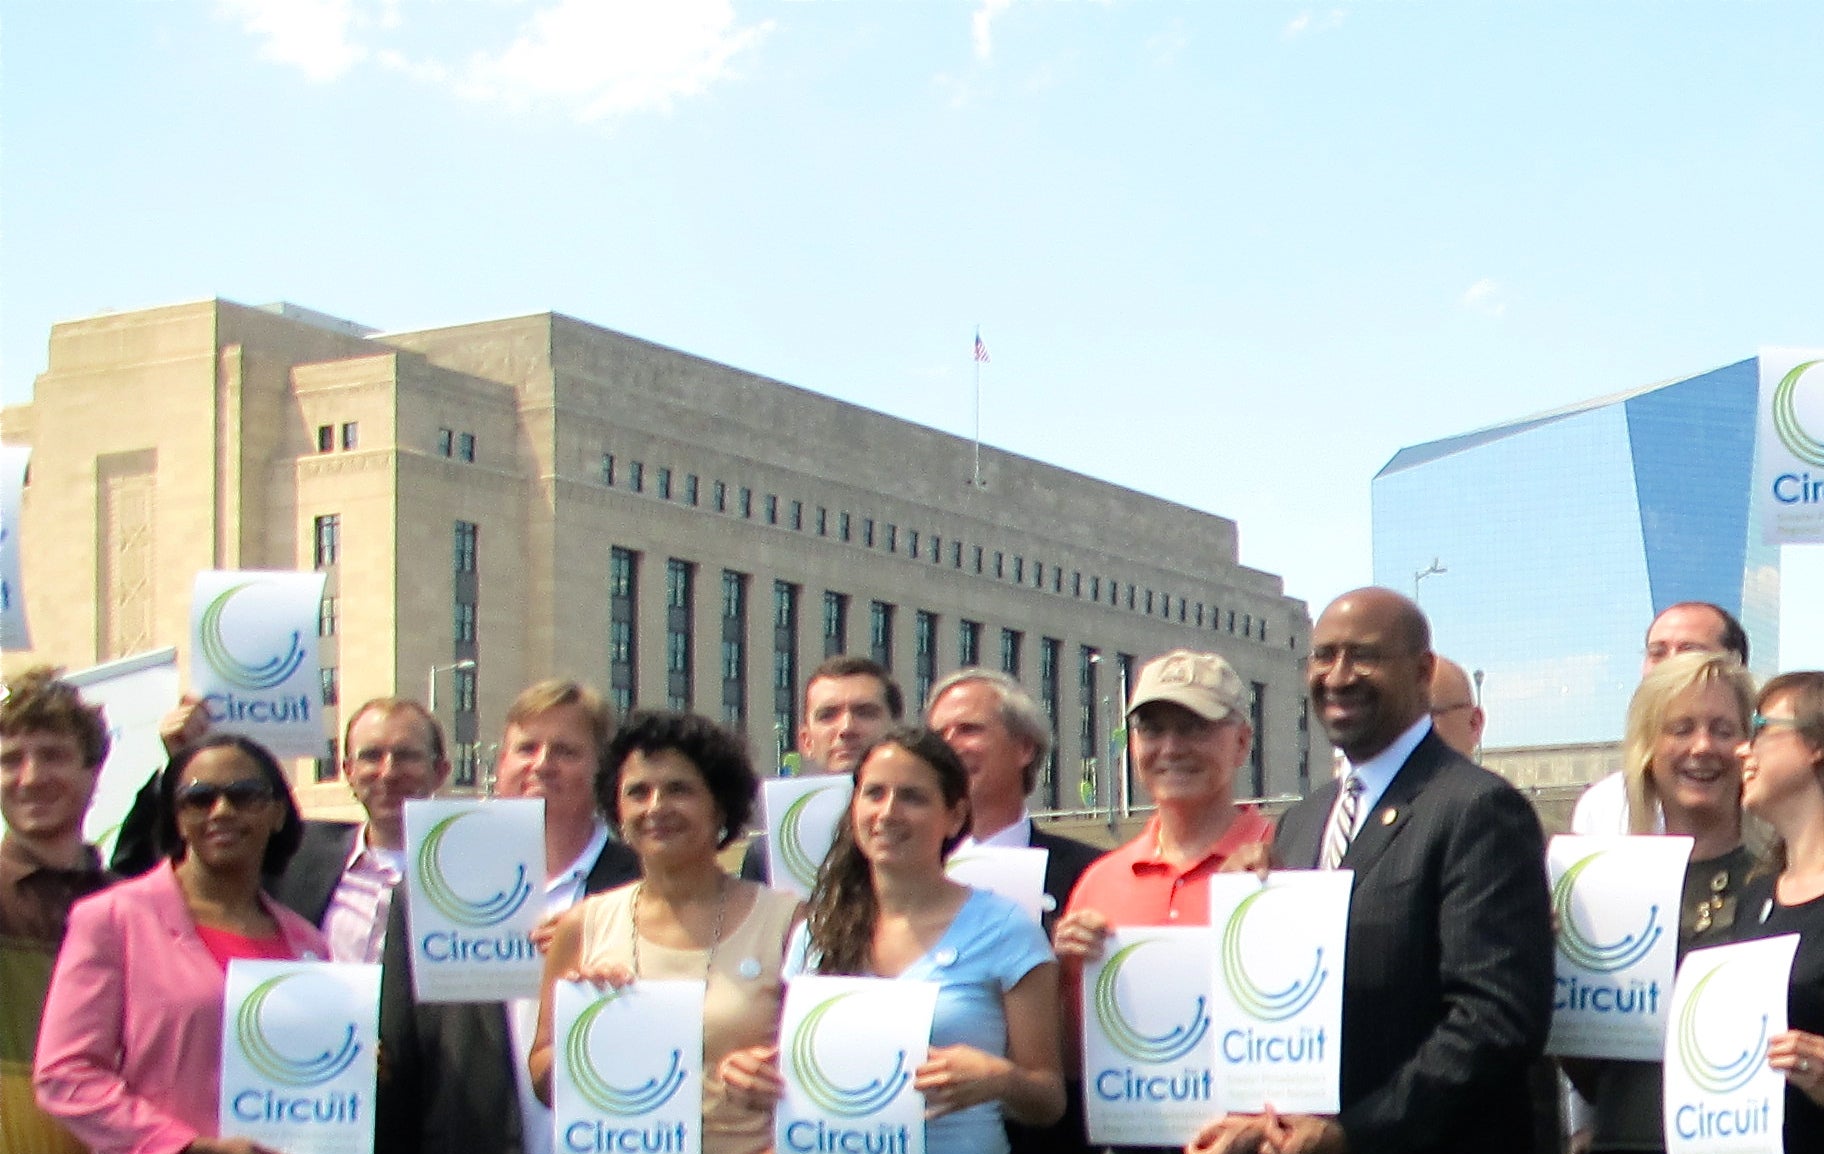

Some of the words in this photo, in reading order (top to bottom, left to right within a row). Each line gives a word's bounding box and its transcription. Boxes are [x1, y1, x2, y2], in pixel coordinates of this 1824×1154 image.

[203, 692, 310, 722] Circuit
[1223, 1026, 1326, 1063] Circuit
[1097, 1067, 1213, 1100] Circuit
[234, 1089, 359, 1122] Circuit
[1676, 1098, 1769, 1140] Circuit
[566, 1120, 688, 1154] Circuit
